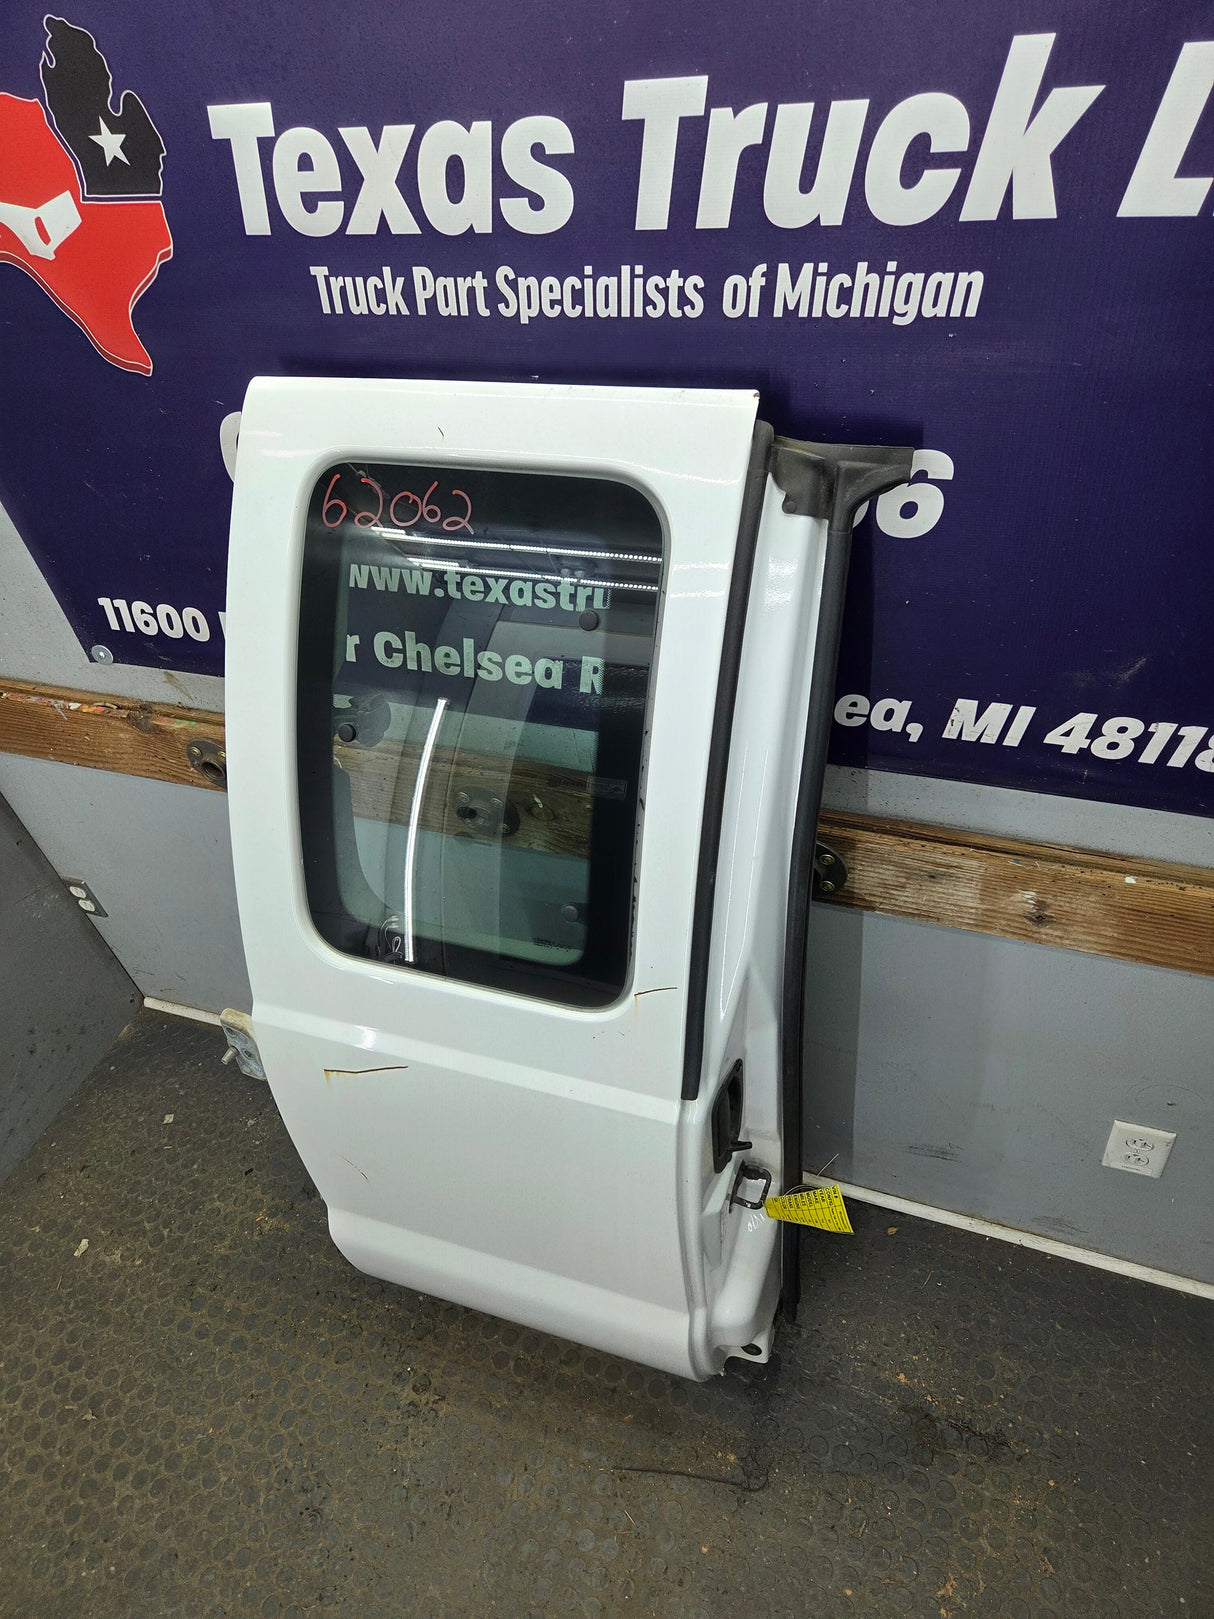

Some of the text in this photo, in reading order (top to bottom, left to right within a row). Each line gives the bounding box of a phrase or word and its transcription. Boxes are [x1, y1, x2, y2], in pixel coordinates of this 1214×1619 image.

[207, 101, 576, 237] Texas
[622, 32, 1107, 231] Truck
[309, 260, 985, 326] Truck Part Specialists of Michigan
[321, 473, 475, 535] 62062
[97, 596, 210, 642] 11600
[373, 630, 564, 690] Chelsea
[941, 698, 1037, 747] MI
